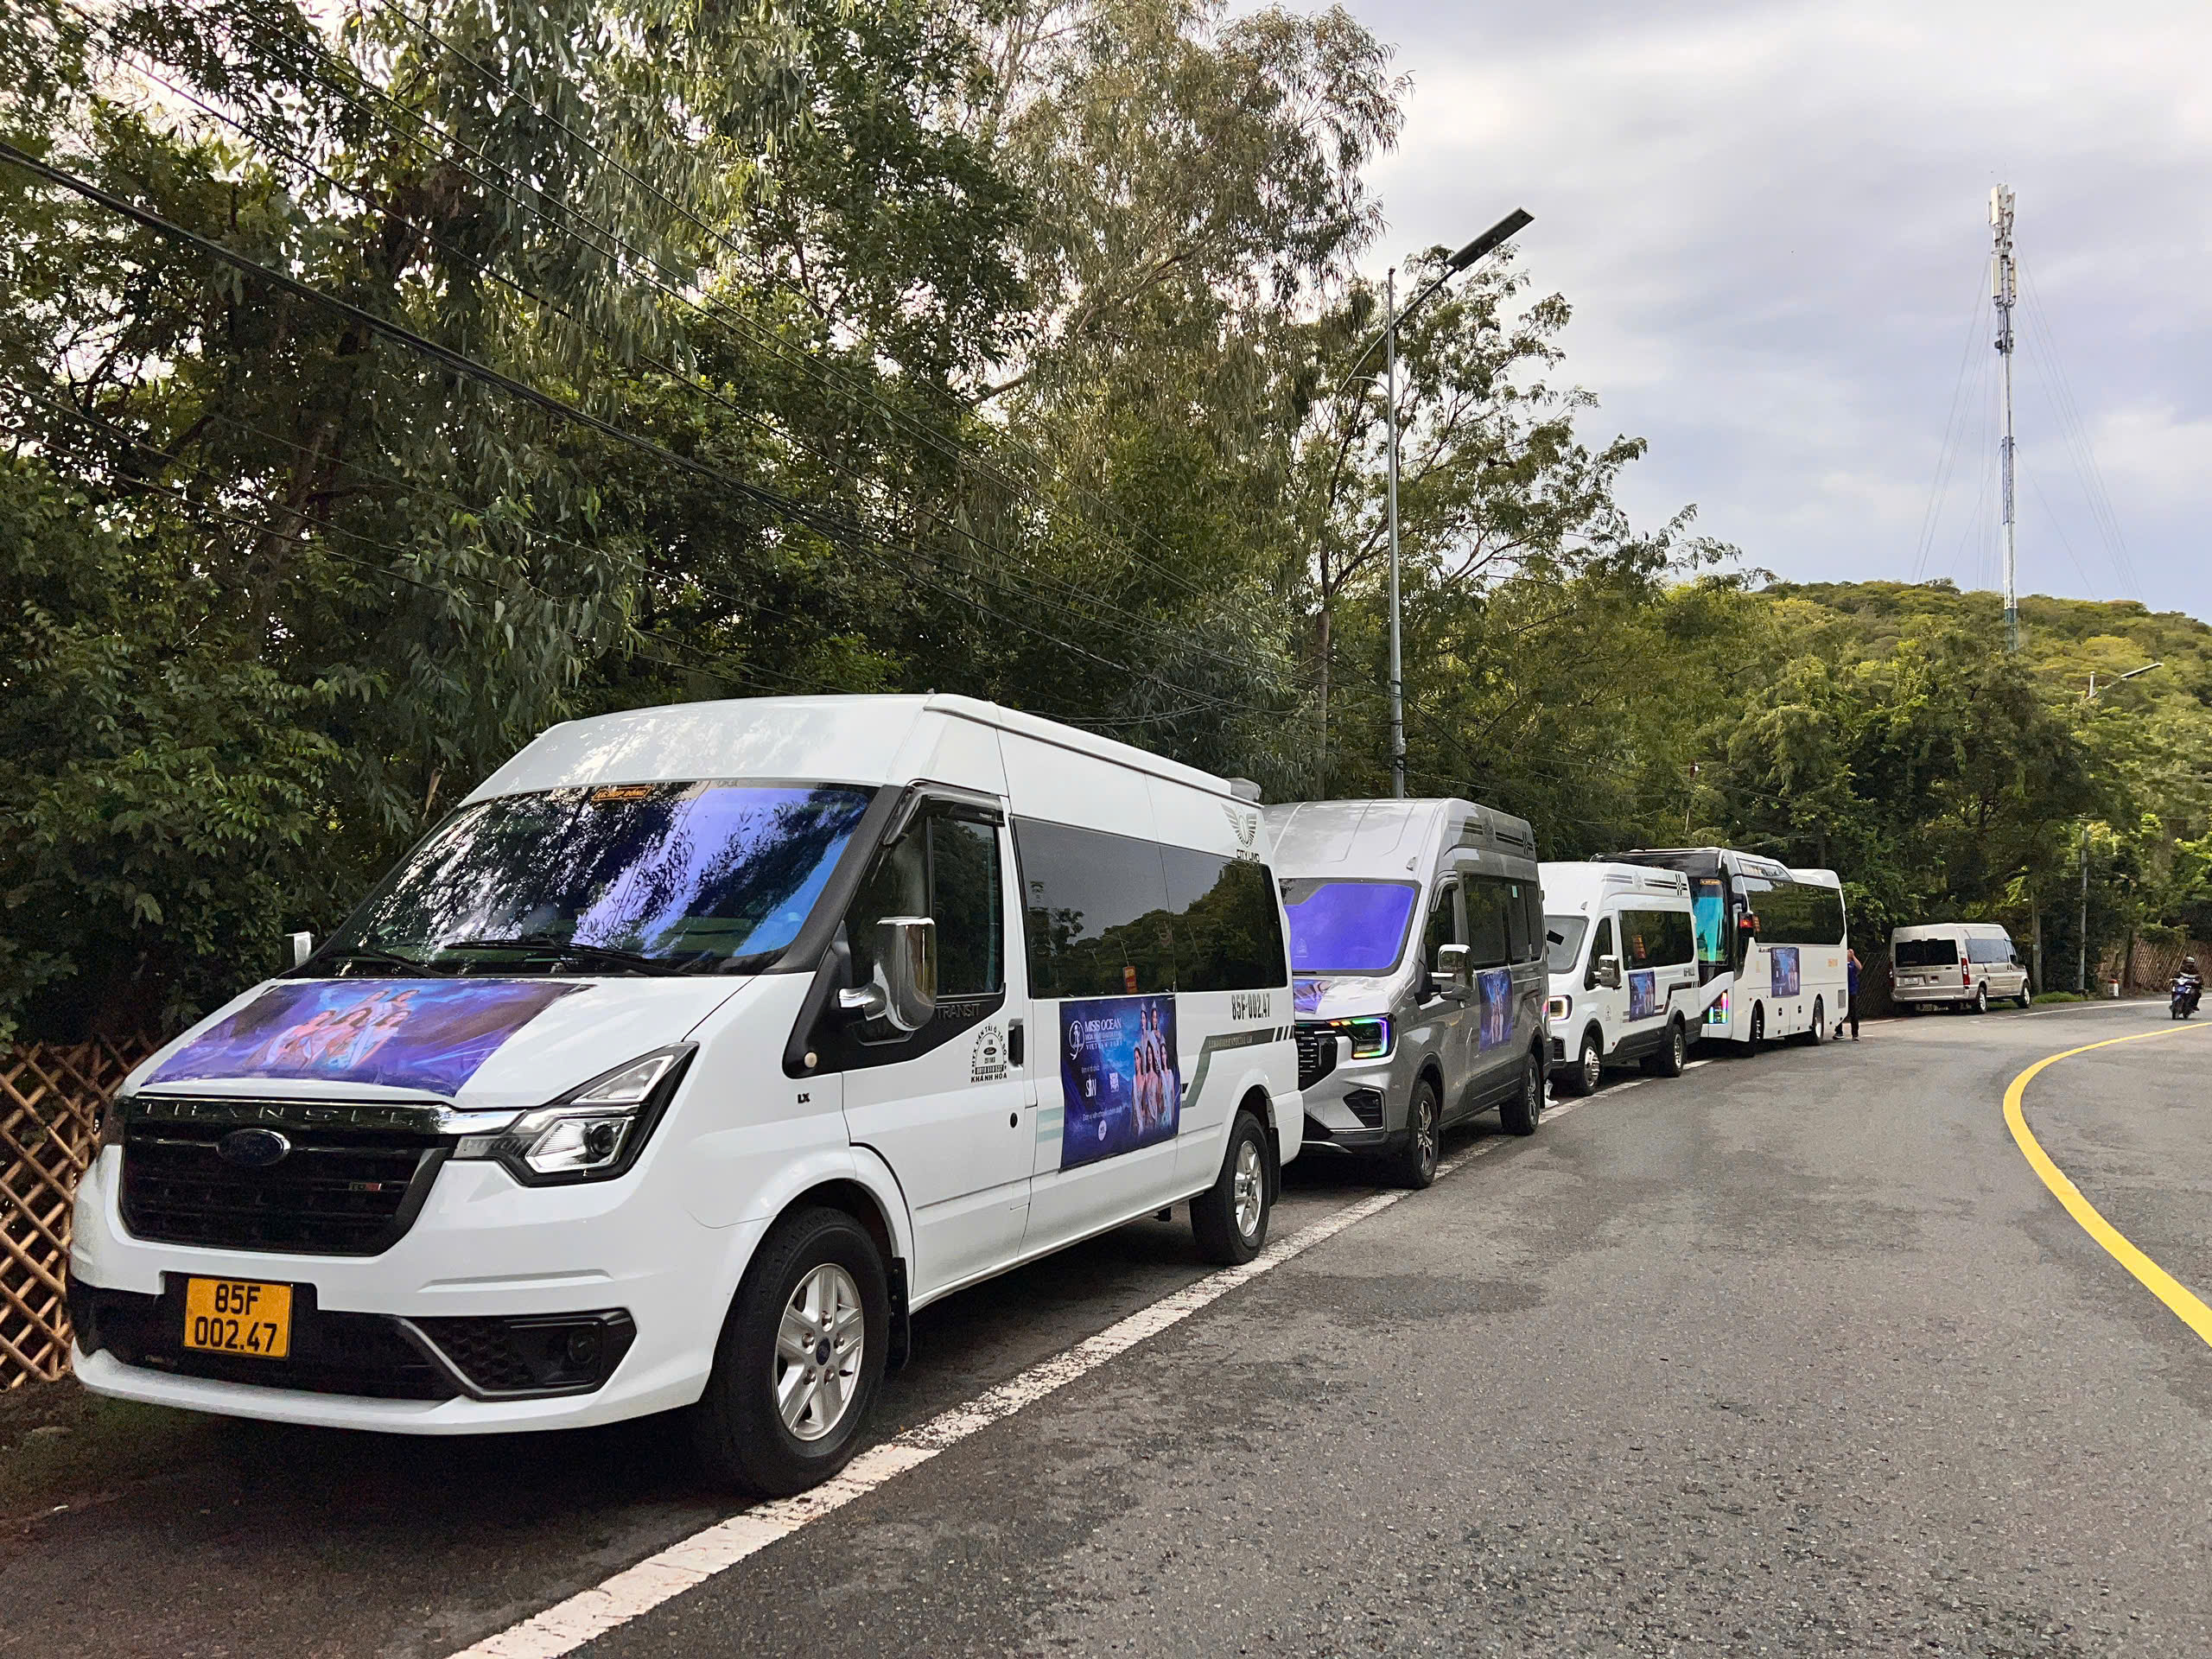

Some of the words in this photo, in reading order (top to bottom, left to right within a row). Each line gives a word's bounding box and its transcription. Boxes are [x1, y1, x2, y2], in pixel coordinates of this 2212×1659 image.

[935, 1003, 981, 1020] TRANSIT
[1084, 1020, 1101, 1033] MISS
[1101, 1018, 1122, 1031] OCEAN
[798, 1092, 810, 1104] LX
[214, 1283, 261, 1316] 85F
[194, 1316, 278, 1353] 002.47
